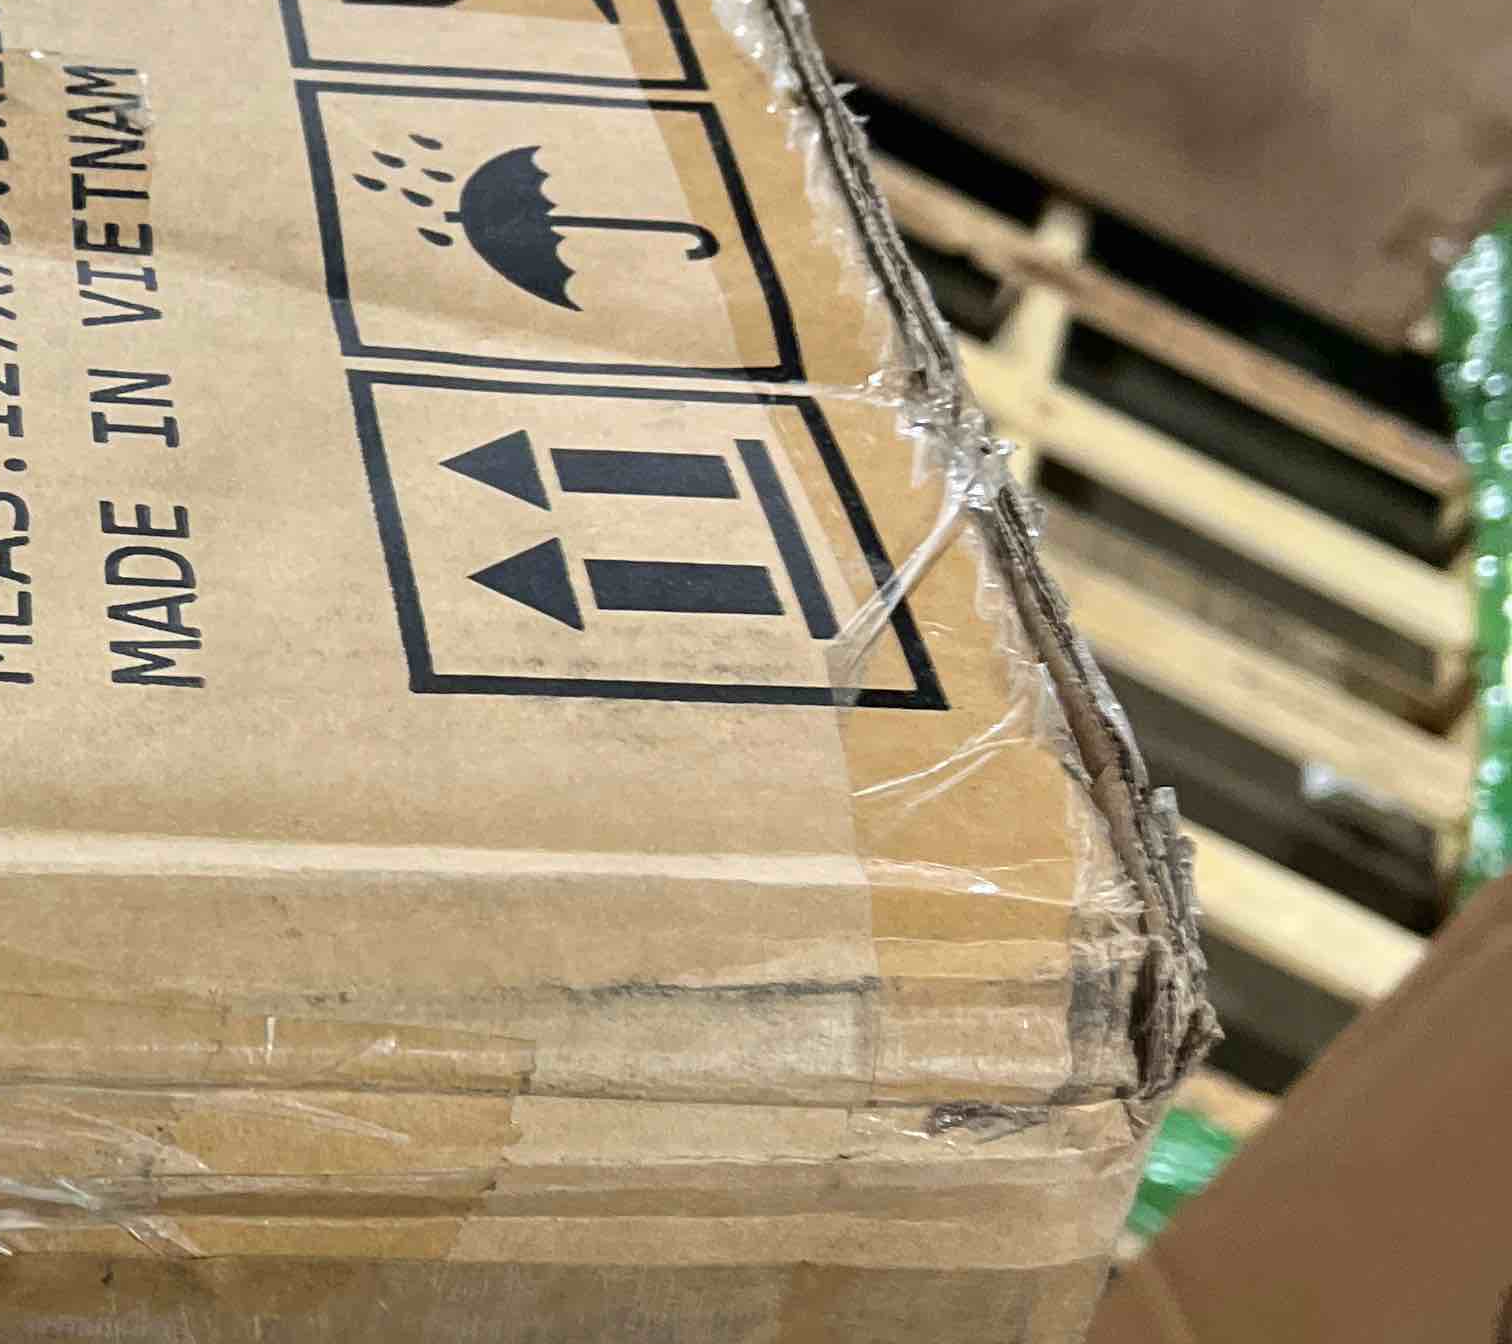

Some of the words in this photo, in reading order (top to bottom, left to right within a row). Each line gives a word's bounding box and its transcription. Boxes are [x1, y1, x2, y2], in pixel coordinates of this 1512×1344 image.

[62, 64, 163, 327] VIETNAM
[88, 367, 180, 448] IN
[99, 500, 206, 689] MADE
